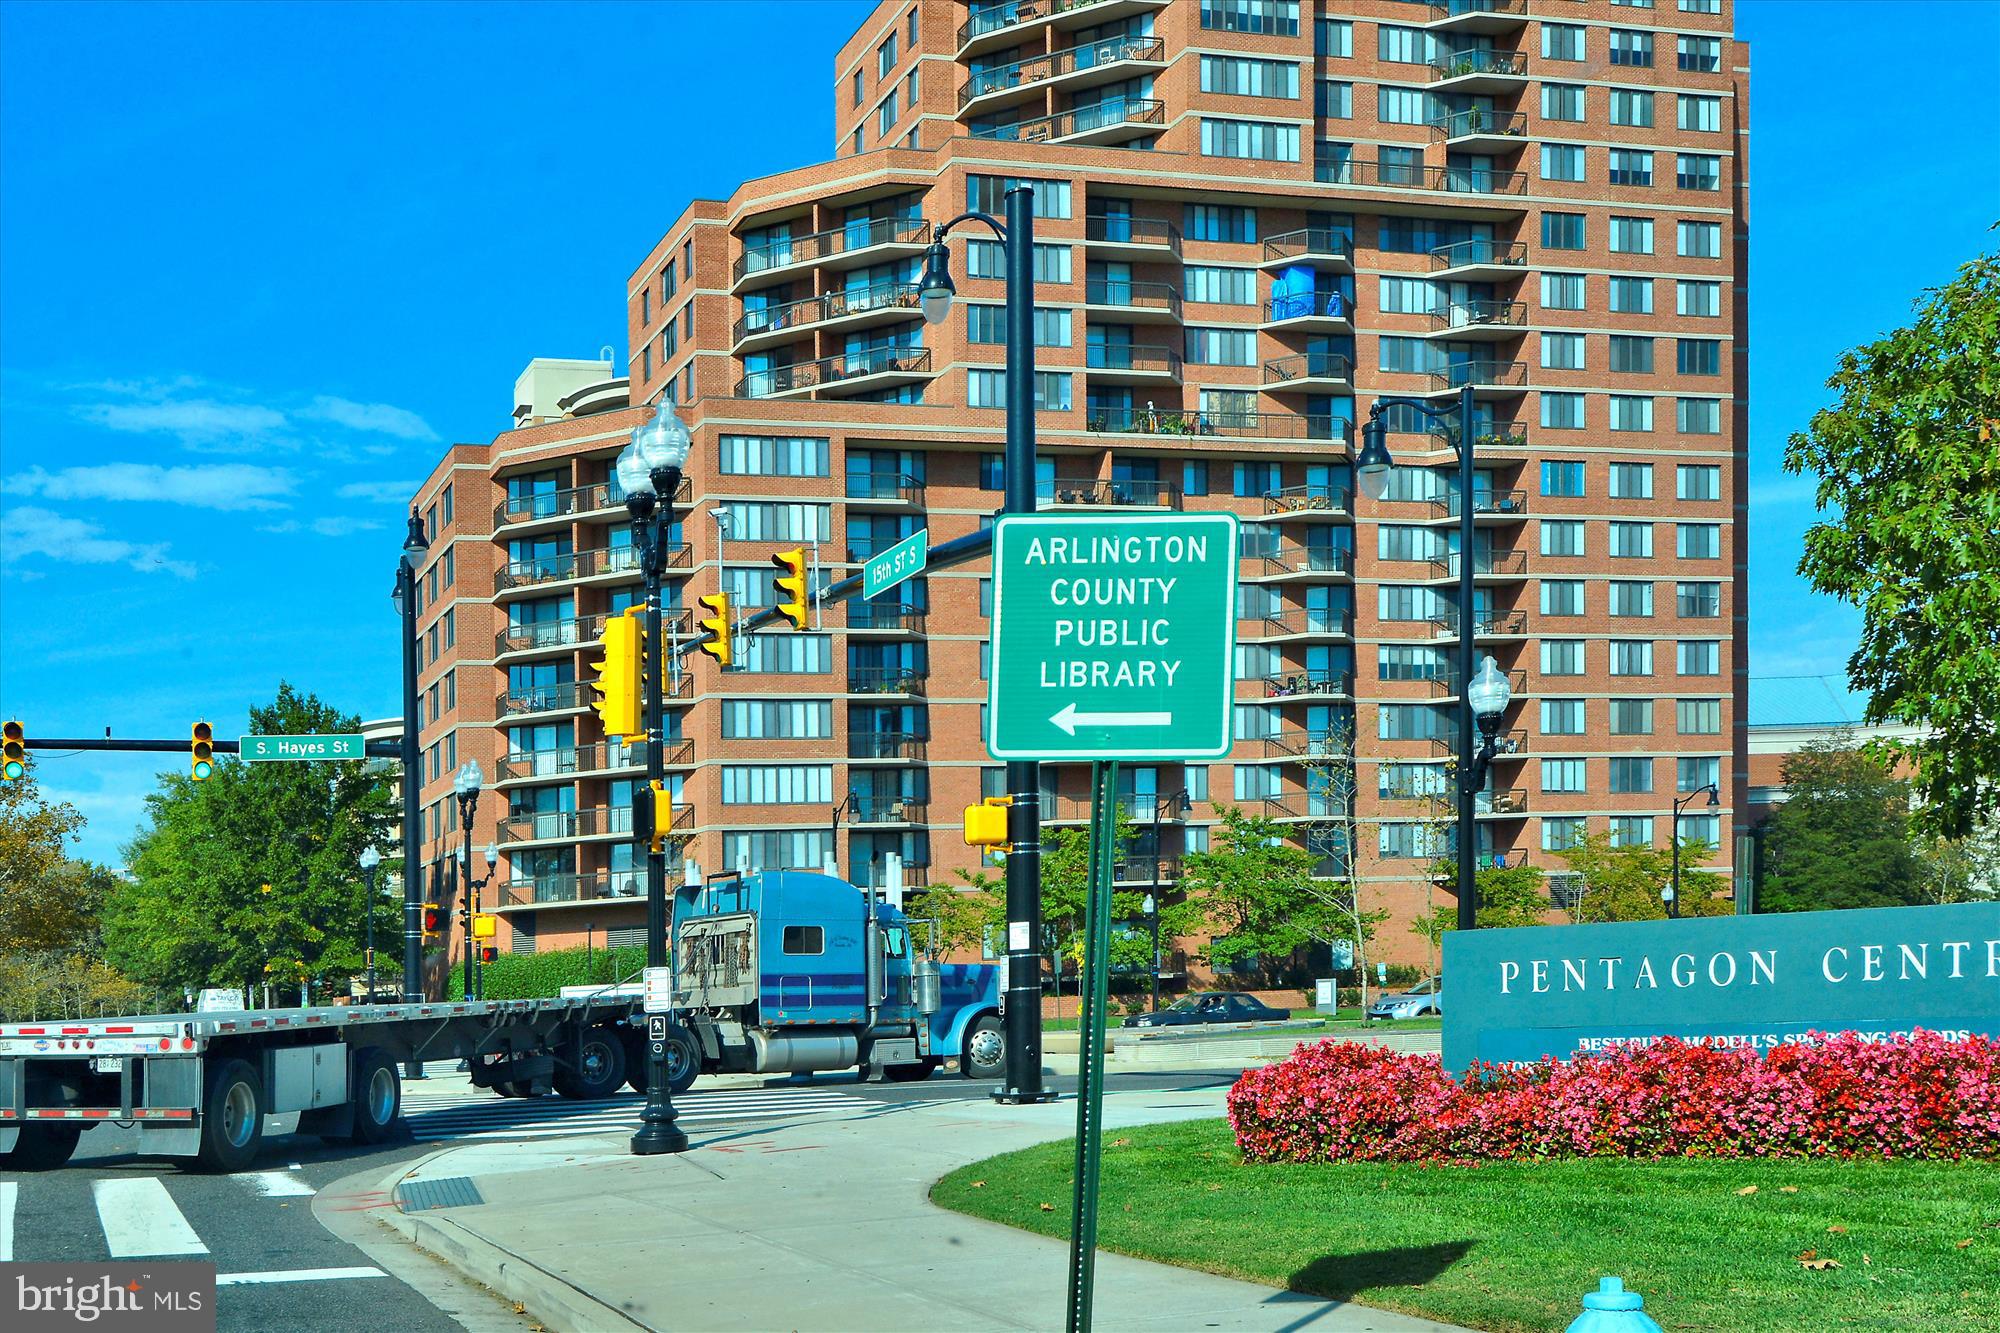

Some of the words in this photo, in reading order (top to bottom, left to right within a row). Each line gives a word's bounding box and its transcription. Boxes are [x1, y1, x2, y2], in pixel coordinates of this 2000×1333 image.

[1024, 535, 1207, 565] ARLINGTON
[872, 562, 892, 585] 15th
[894, 550, 907, 573] ST
[909, 545, 916, 565] S
[1050, 577, 1177, 606] COUNTY
[1055, 619, 1170, 647] PUBLIC
[1040, 660, 1182, 688] LIBRARY
[256, 742, 271, 754] S.
[278, 741, 325, 757] Hayes
[332, 740, 349, 753] St
[1499, 950, 1778, 994] PENTAGON
[1578, 1037, 1625, 1051] BEST
